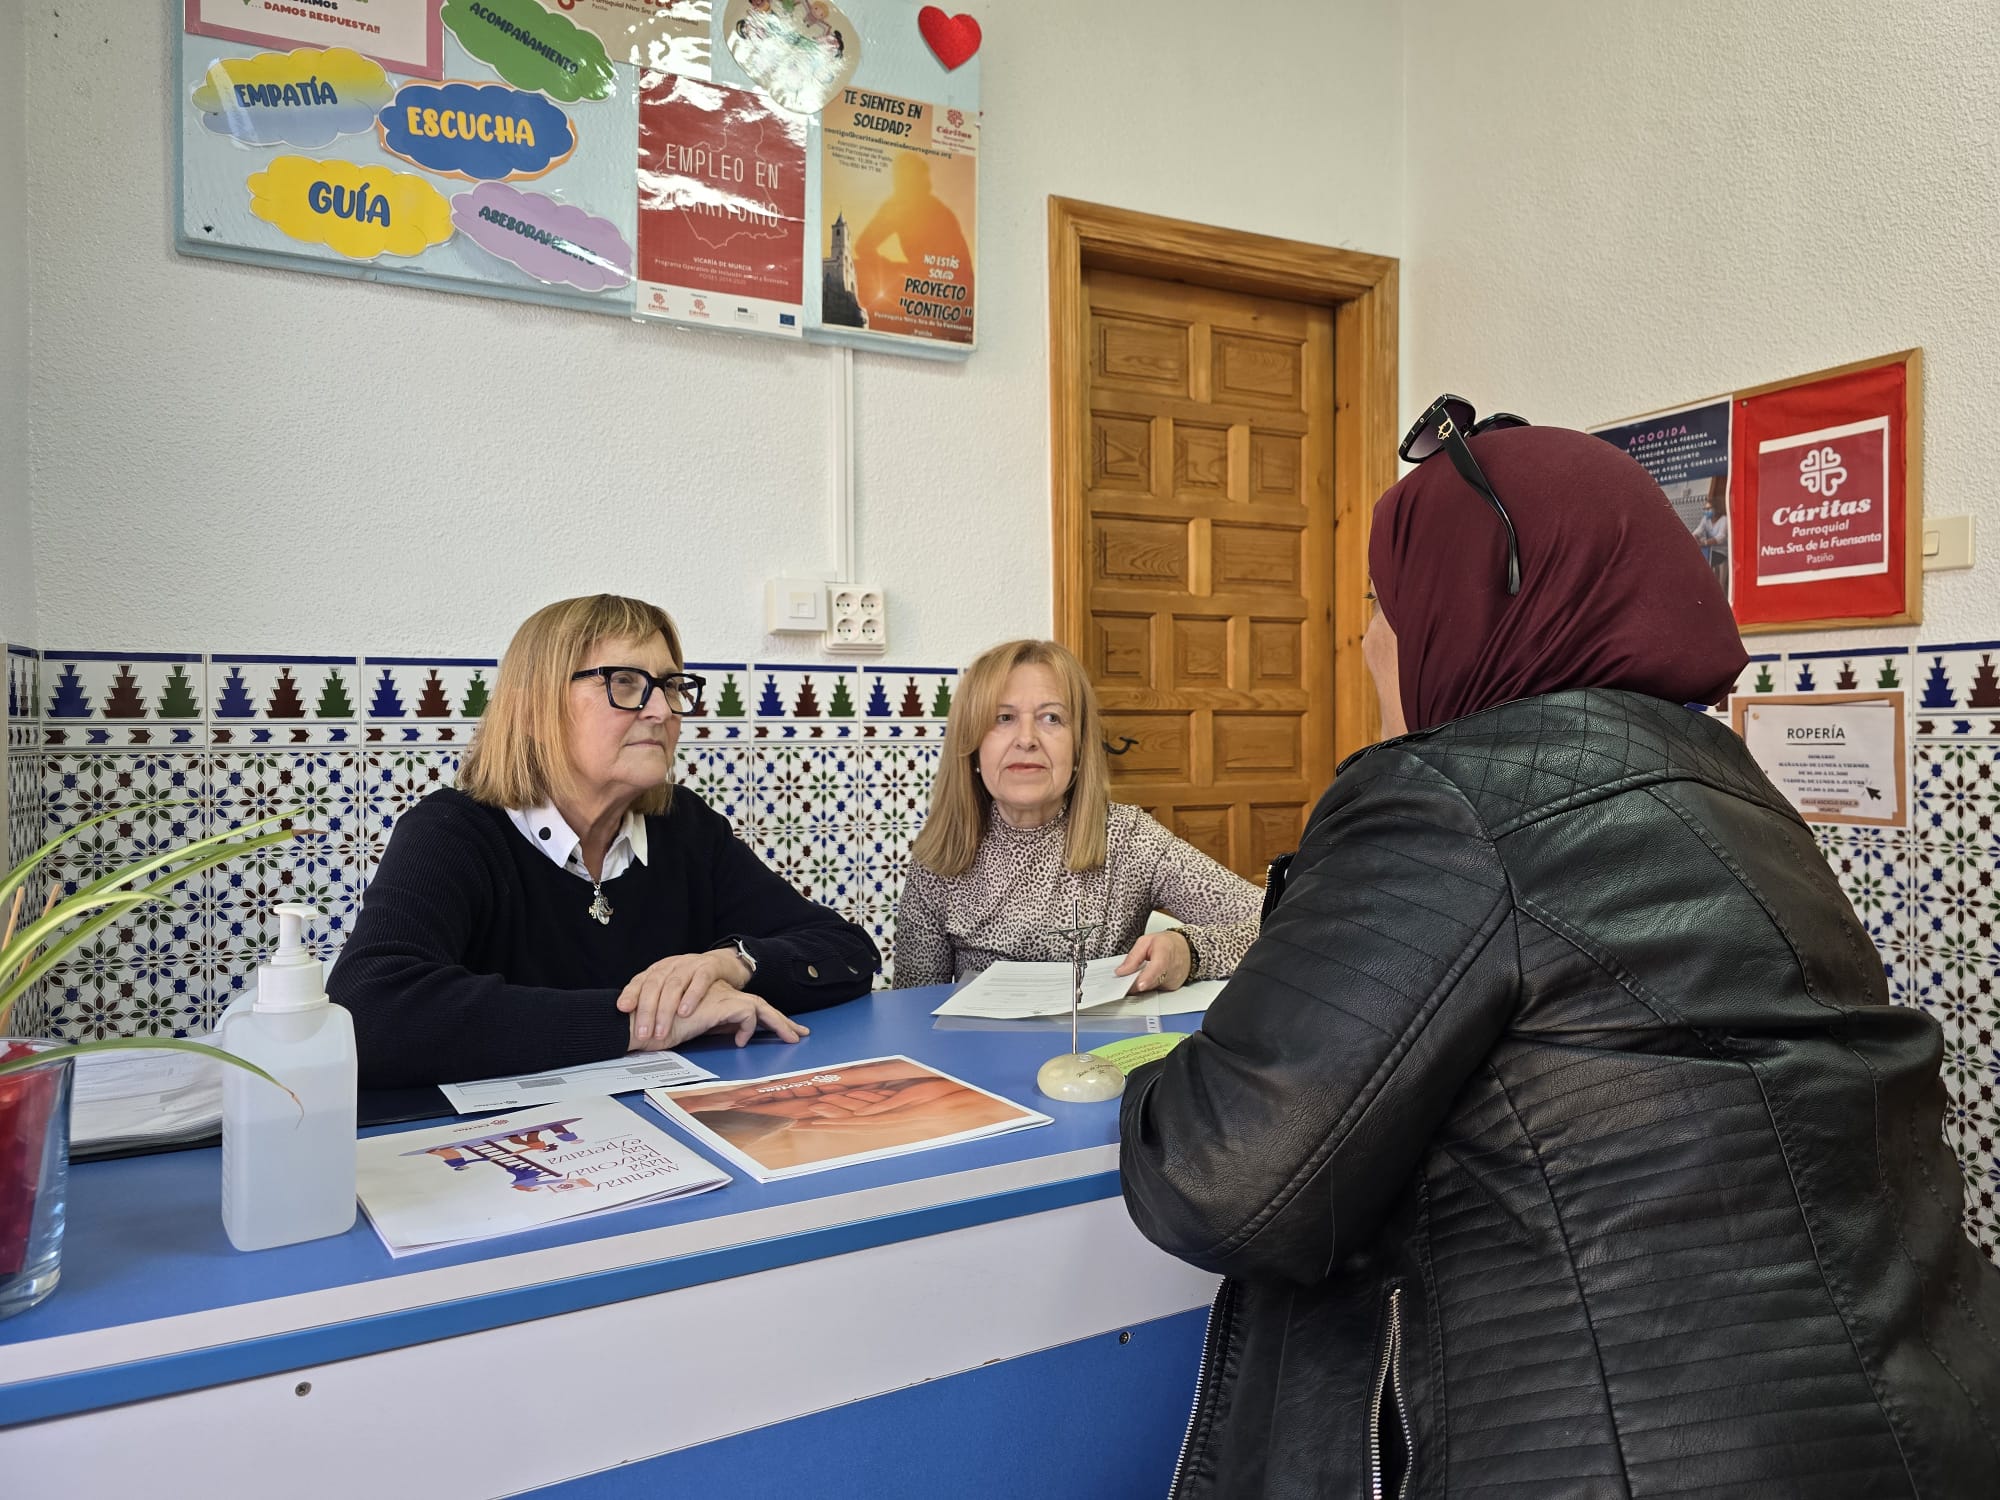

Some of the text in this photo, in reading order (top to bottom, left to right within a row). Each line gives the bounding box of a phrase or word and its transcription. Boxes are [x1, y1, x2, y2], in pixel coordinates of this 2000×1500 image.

[264, 2, 307, 17] DAMOS
[309, 12, 381, 34] RESPUESTA!!
[469, 2, 579, 75] ACOMPAÑAMIENTO
[233, 76, 338, 108] EMPATÍA
[845, 89, 923, 119] TE SIENTES EN
[407, 106, 535, 147] ESCUCHA
[853, 112, 912, 137] SOLEDAD?
[666, 143, 779, 189] EMPLEO EN
[308, 181, 391, 227] GUÍA
[478, 206, 597, 265] ASESORAMTO
[924, 254, 936, 265] NO
[904, 277, 967, 301] PROYECTO
[899, 297, 961, 321] "CONTIGO
[1772, 498, 1871, 526] Cáritas
[1791, 518, 1850, 537] Parroquial
[1761, 532, 1882, 556] Ntra. Sra. de la Fuensanta
[1806, 553, 1835, 564] Patiño
[1787, 724, 1846, 739] ROPERÍA
[548, 1138, 642, 1165] esperanza
[621, 1143, 657, 1156] hay
[567, 1149, 661, 1180] personas
[593, 1163, 680, 1192] Mientras
[627, 1156, 673, 1172] haya
